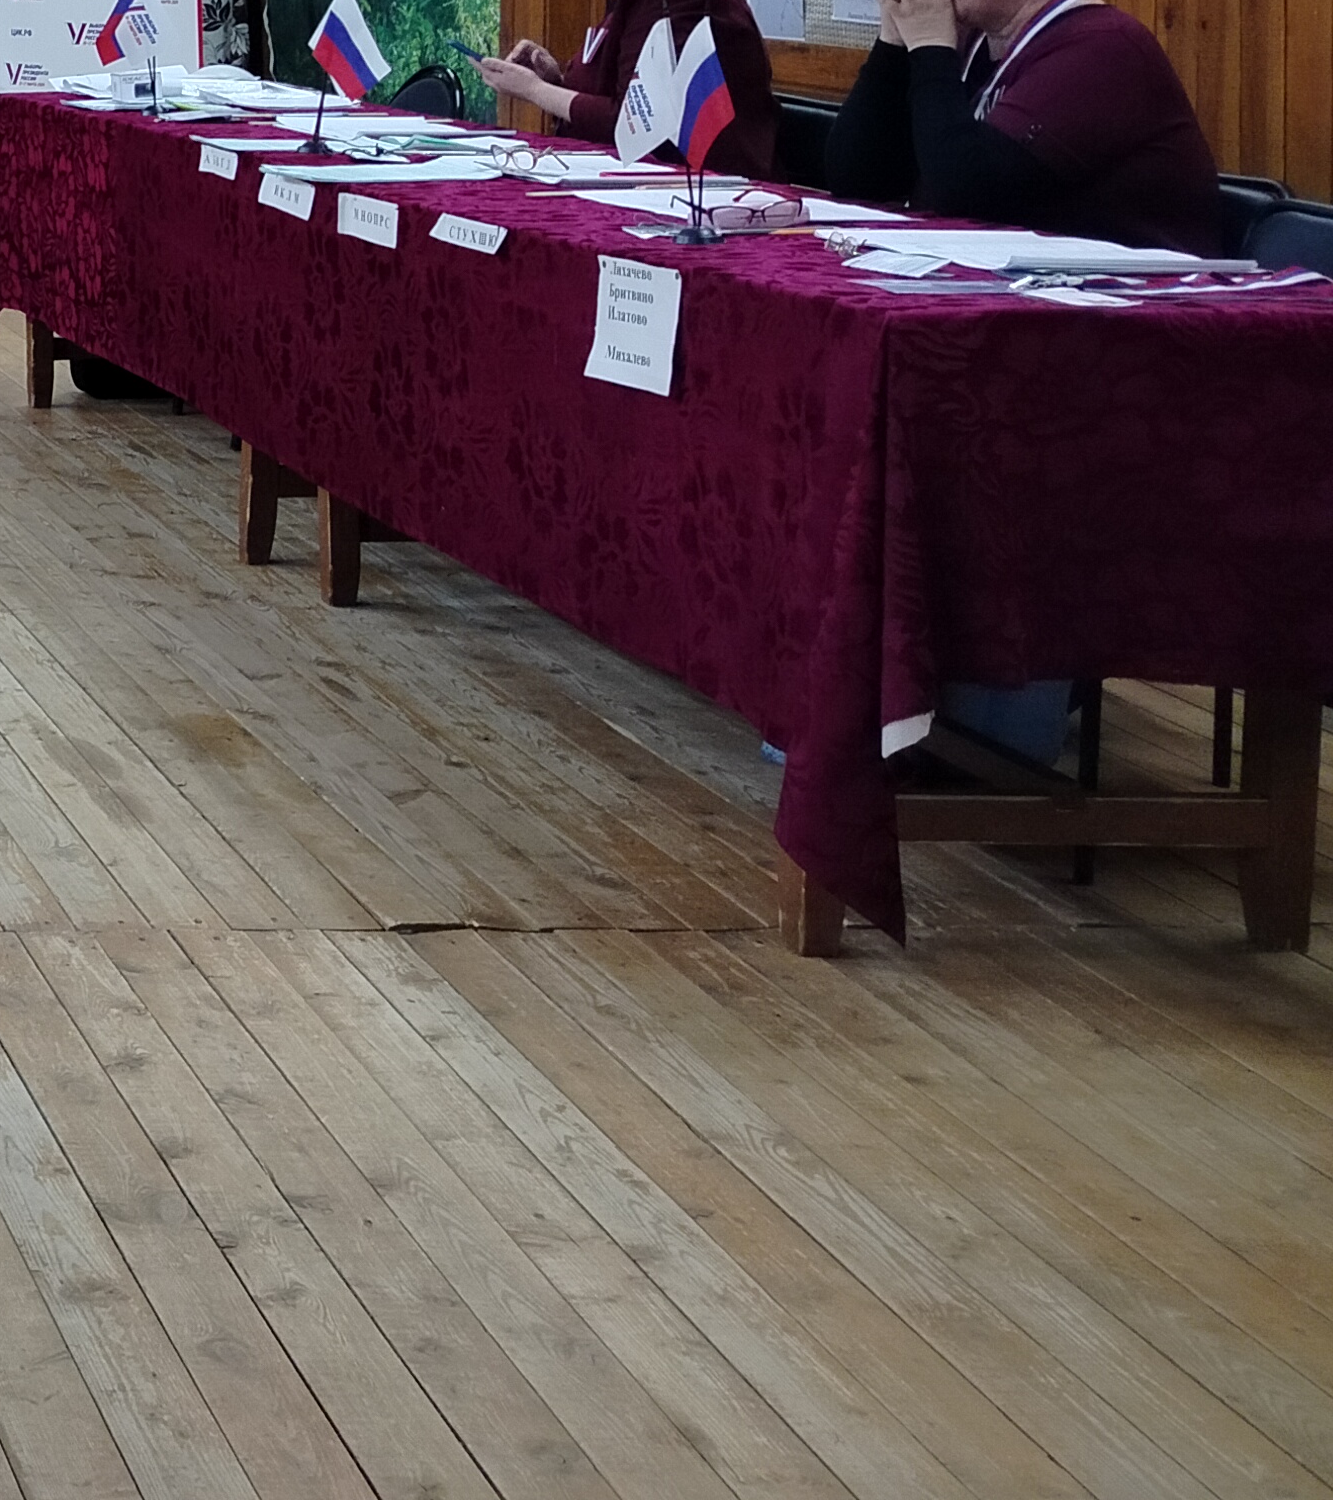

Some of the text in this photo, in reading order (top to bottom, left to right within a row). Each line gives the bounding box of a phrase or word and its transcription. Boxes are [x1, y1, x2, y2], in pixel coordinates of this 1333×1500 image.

[353, 208, 390, 229] МНОПРС
[449, 225, 498, 248] СТУХШЮ
[609, 261, 652, 281] Лихачево
[609, 283, 654, 304] Бритвино
